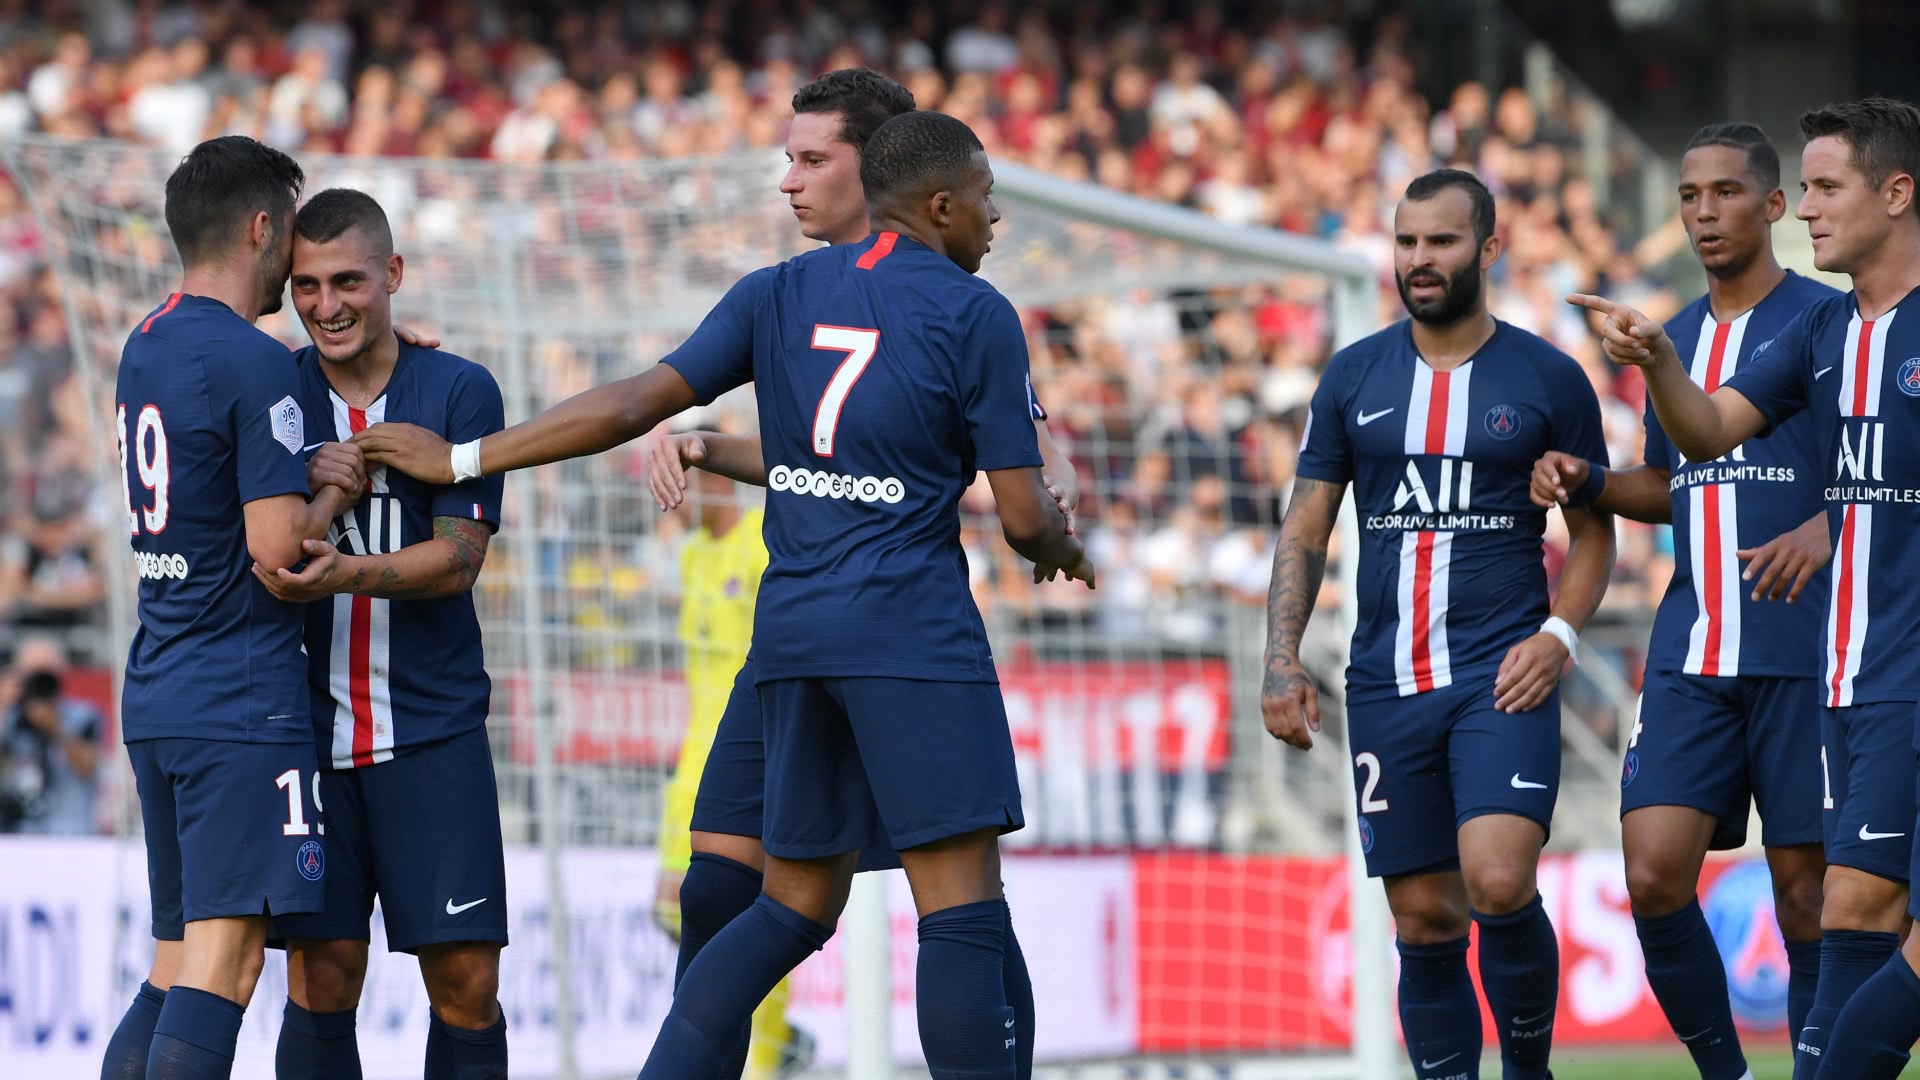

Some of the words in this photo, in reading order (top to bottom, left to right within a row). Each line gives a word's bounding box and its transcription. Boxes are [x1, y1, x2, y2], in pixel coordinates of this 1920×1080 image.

[810, 323, 881, 457] 7
[117, 403, 170, 536] 19
[769, 464, 905, 503] ooredoo
[1687, 467, 1716, 485] LIVE
[1718, 465, 1796, 482] LIMITLESS
[1439, 514, 1515, 529] LIMITLESS
[1355, 751, 1389, 814] 2
[302, 843, 320, 853] PARIS
